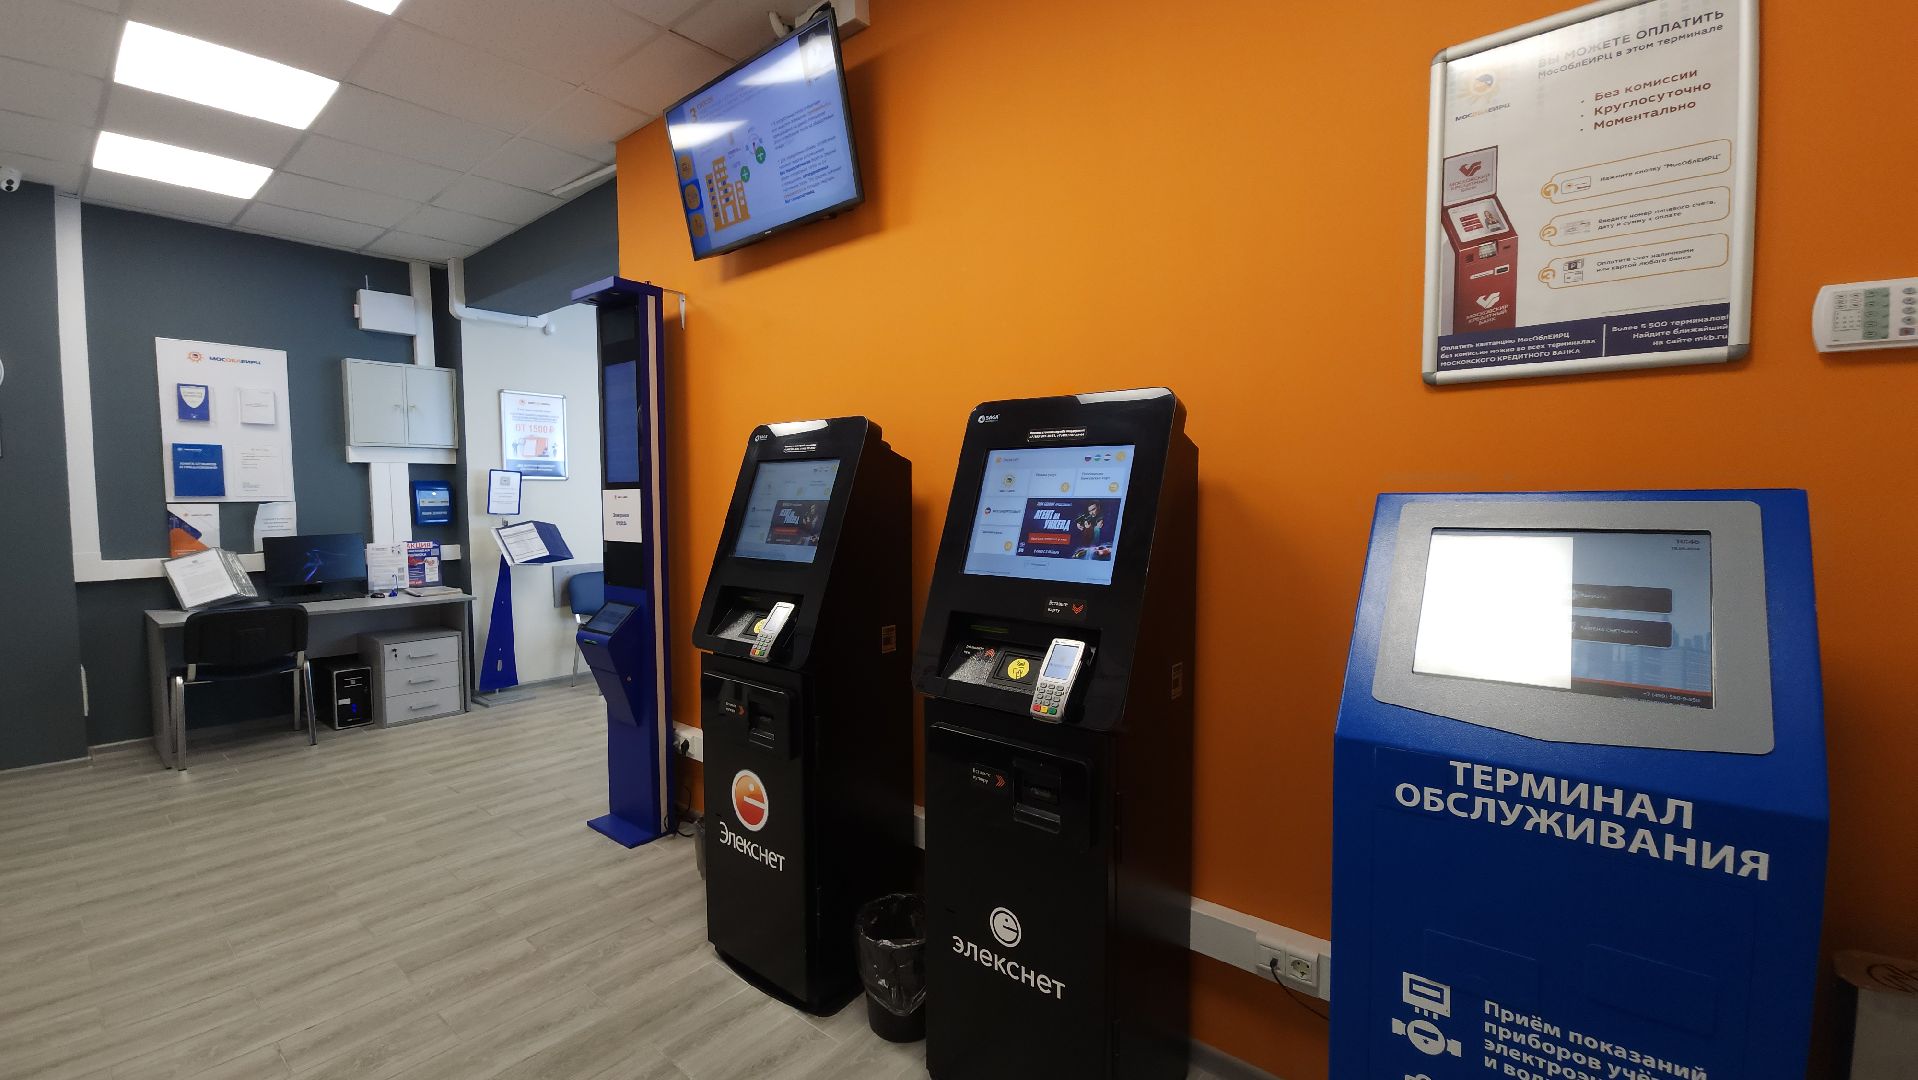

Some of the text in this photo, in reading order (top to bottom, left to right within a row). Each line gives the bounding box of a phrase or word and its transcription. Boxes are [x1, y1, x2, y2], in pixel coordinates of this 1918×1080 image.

[1538, 52, 1613, 79] МосОблЕИРЦ
[1626, 42, 1654, 55] этом
[1657, 24, 1723, 47] терминале
[1564, 35, 1631, 60] МОЖЕТЕ
[1636, 10, 1724, 39] ОПЛАТИТЬ
[1594, 69, 1698, 101] Без комиссии
[1594, 82, 1712, 117] Круглосуточно
[1593, 101, 1697, 130] Моментально
[1632, 323, 1729, 340] Найдите ближайший
[1648, 321, 1668, 329] 500
[1666, 337, 1692, 345] сайте
[1694, 333, 1728, 342] mkb.ru
[1497, 350, 1550, 362] КРЕДИТНОГО
[1449, 760, 1694, 830] ТЕРМИНАЛ
[720, 821, 785, 872] Элекснет
[1394, 782, 1769, 881] ОБСЛУЖИВАНИЯ
[1484, 999, 1708, 1080] Приём показаний
[1484, 1020, 1660, 1080] приборов учё
[1484, 1054, 1497, 1070] и
